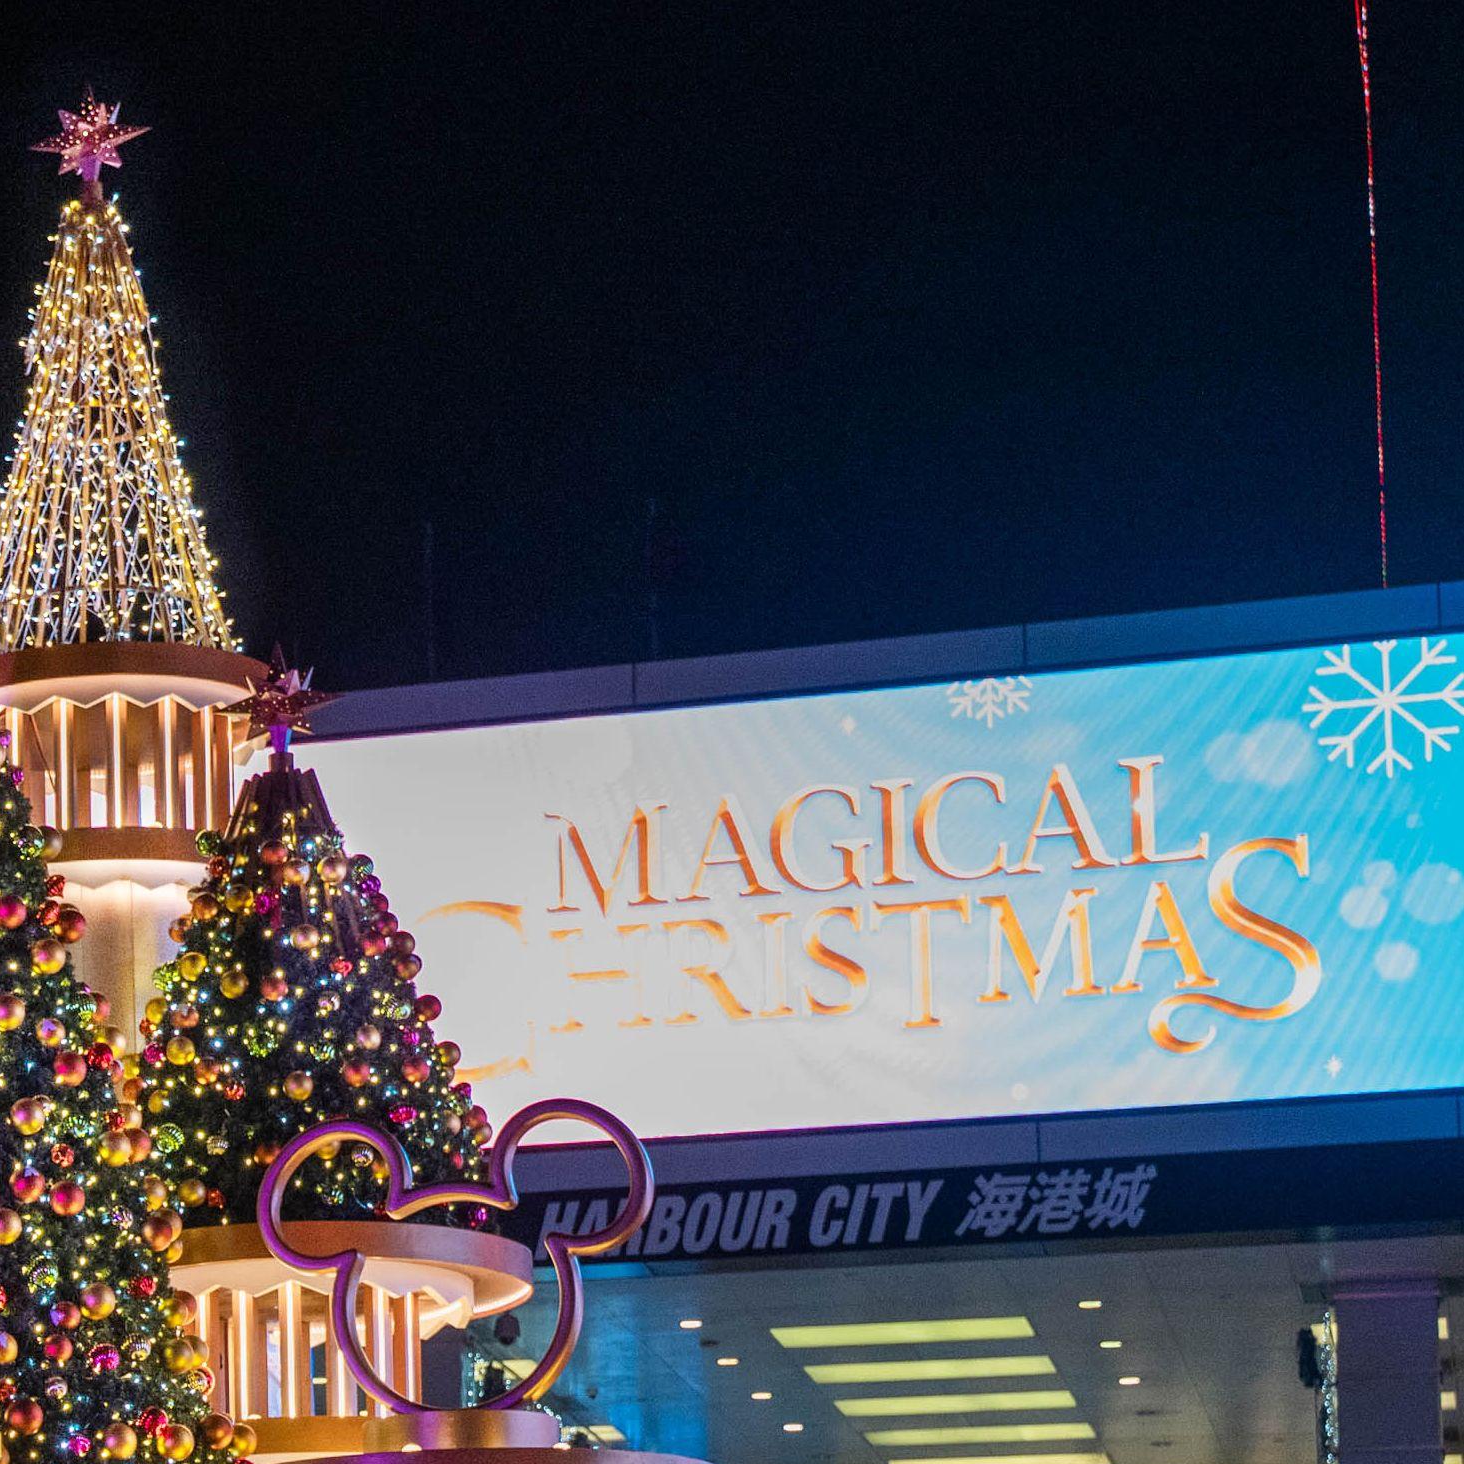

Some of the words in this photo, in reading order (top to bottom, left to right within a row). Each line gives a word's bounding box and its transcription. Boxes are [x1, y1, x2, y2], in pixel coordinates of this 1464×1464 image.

[543, 754, 1210, 918] MAGICAL
[808, 1179, 946, 1248] CITY
[954, 1163, 1159, 1238] 海港城
